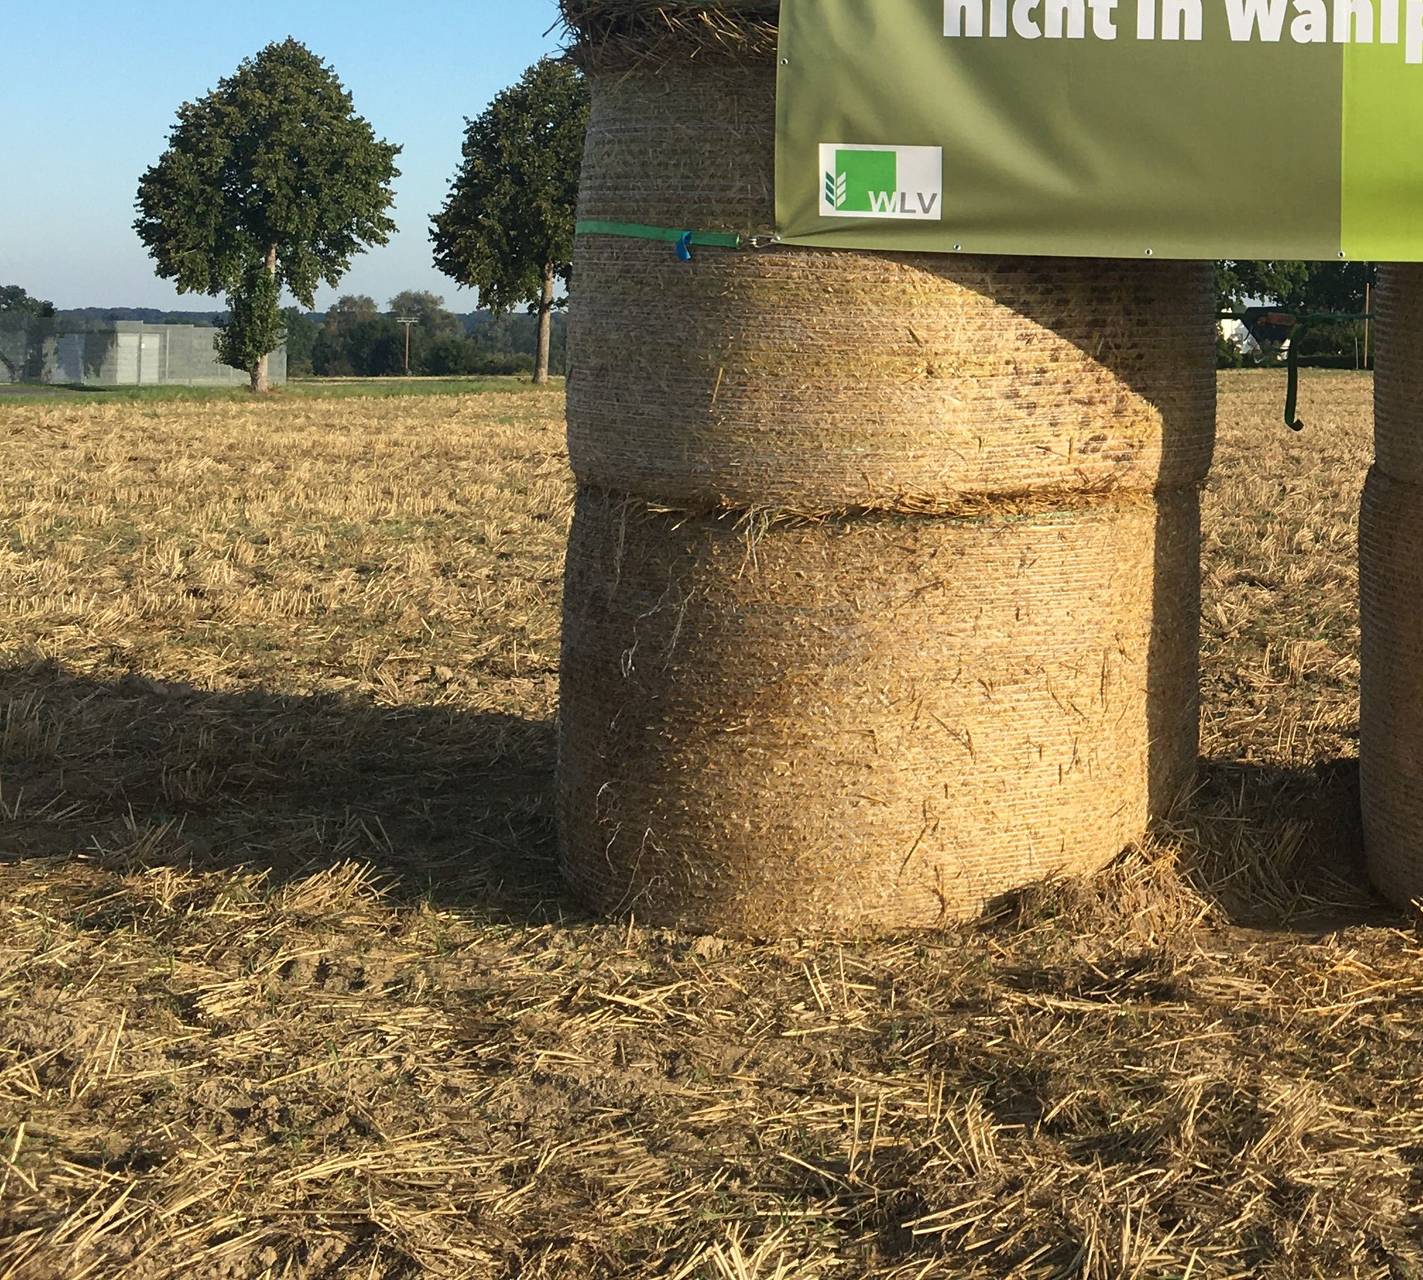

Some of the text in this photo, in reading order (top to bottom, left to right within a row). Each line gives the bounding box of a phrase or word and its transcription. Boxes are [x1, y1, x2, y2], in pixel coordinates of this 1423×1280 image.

[943, 0, 1119, 40] nicht
[1136, 0, 1203, 41] in
[867, 190, 938, 214] WLV
